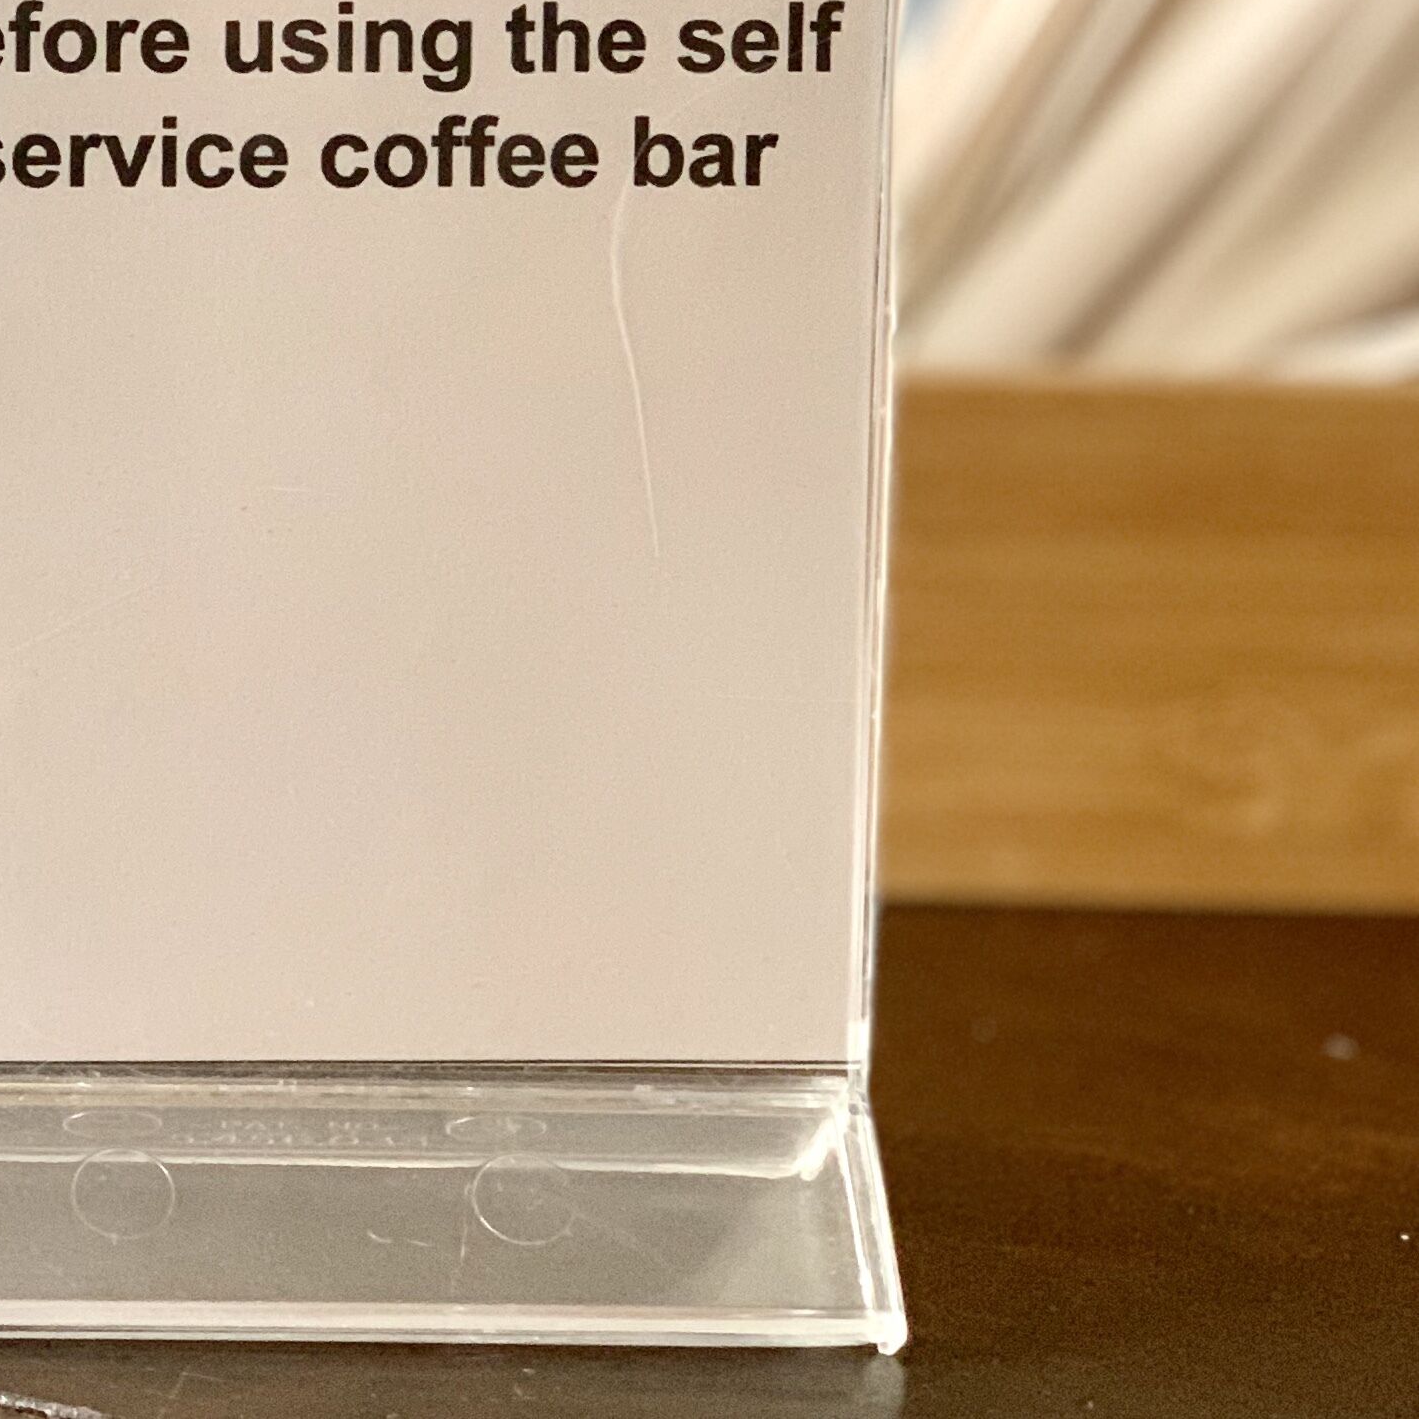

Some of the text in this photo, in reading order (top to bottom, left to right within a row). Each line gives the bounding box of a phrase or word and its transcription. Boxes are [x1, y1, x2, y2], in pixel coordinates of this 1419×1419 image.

[225, 1, 472, 93] using
[505, 1, 646, 74] the
[677, 0, 845, 74] self
[321, 114, 599, 189] coffee
[633, 115, 779, 189] bar
